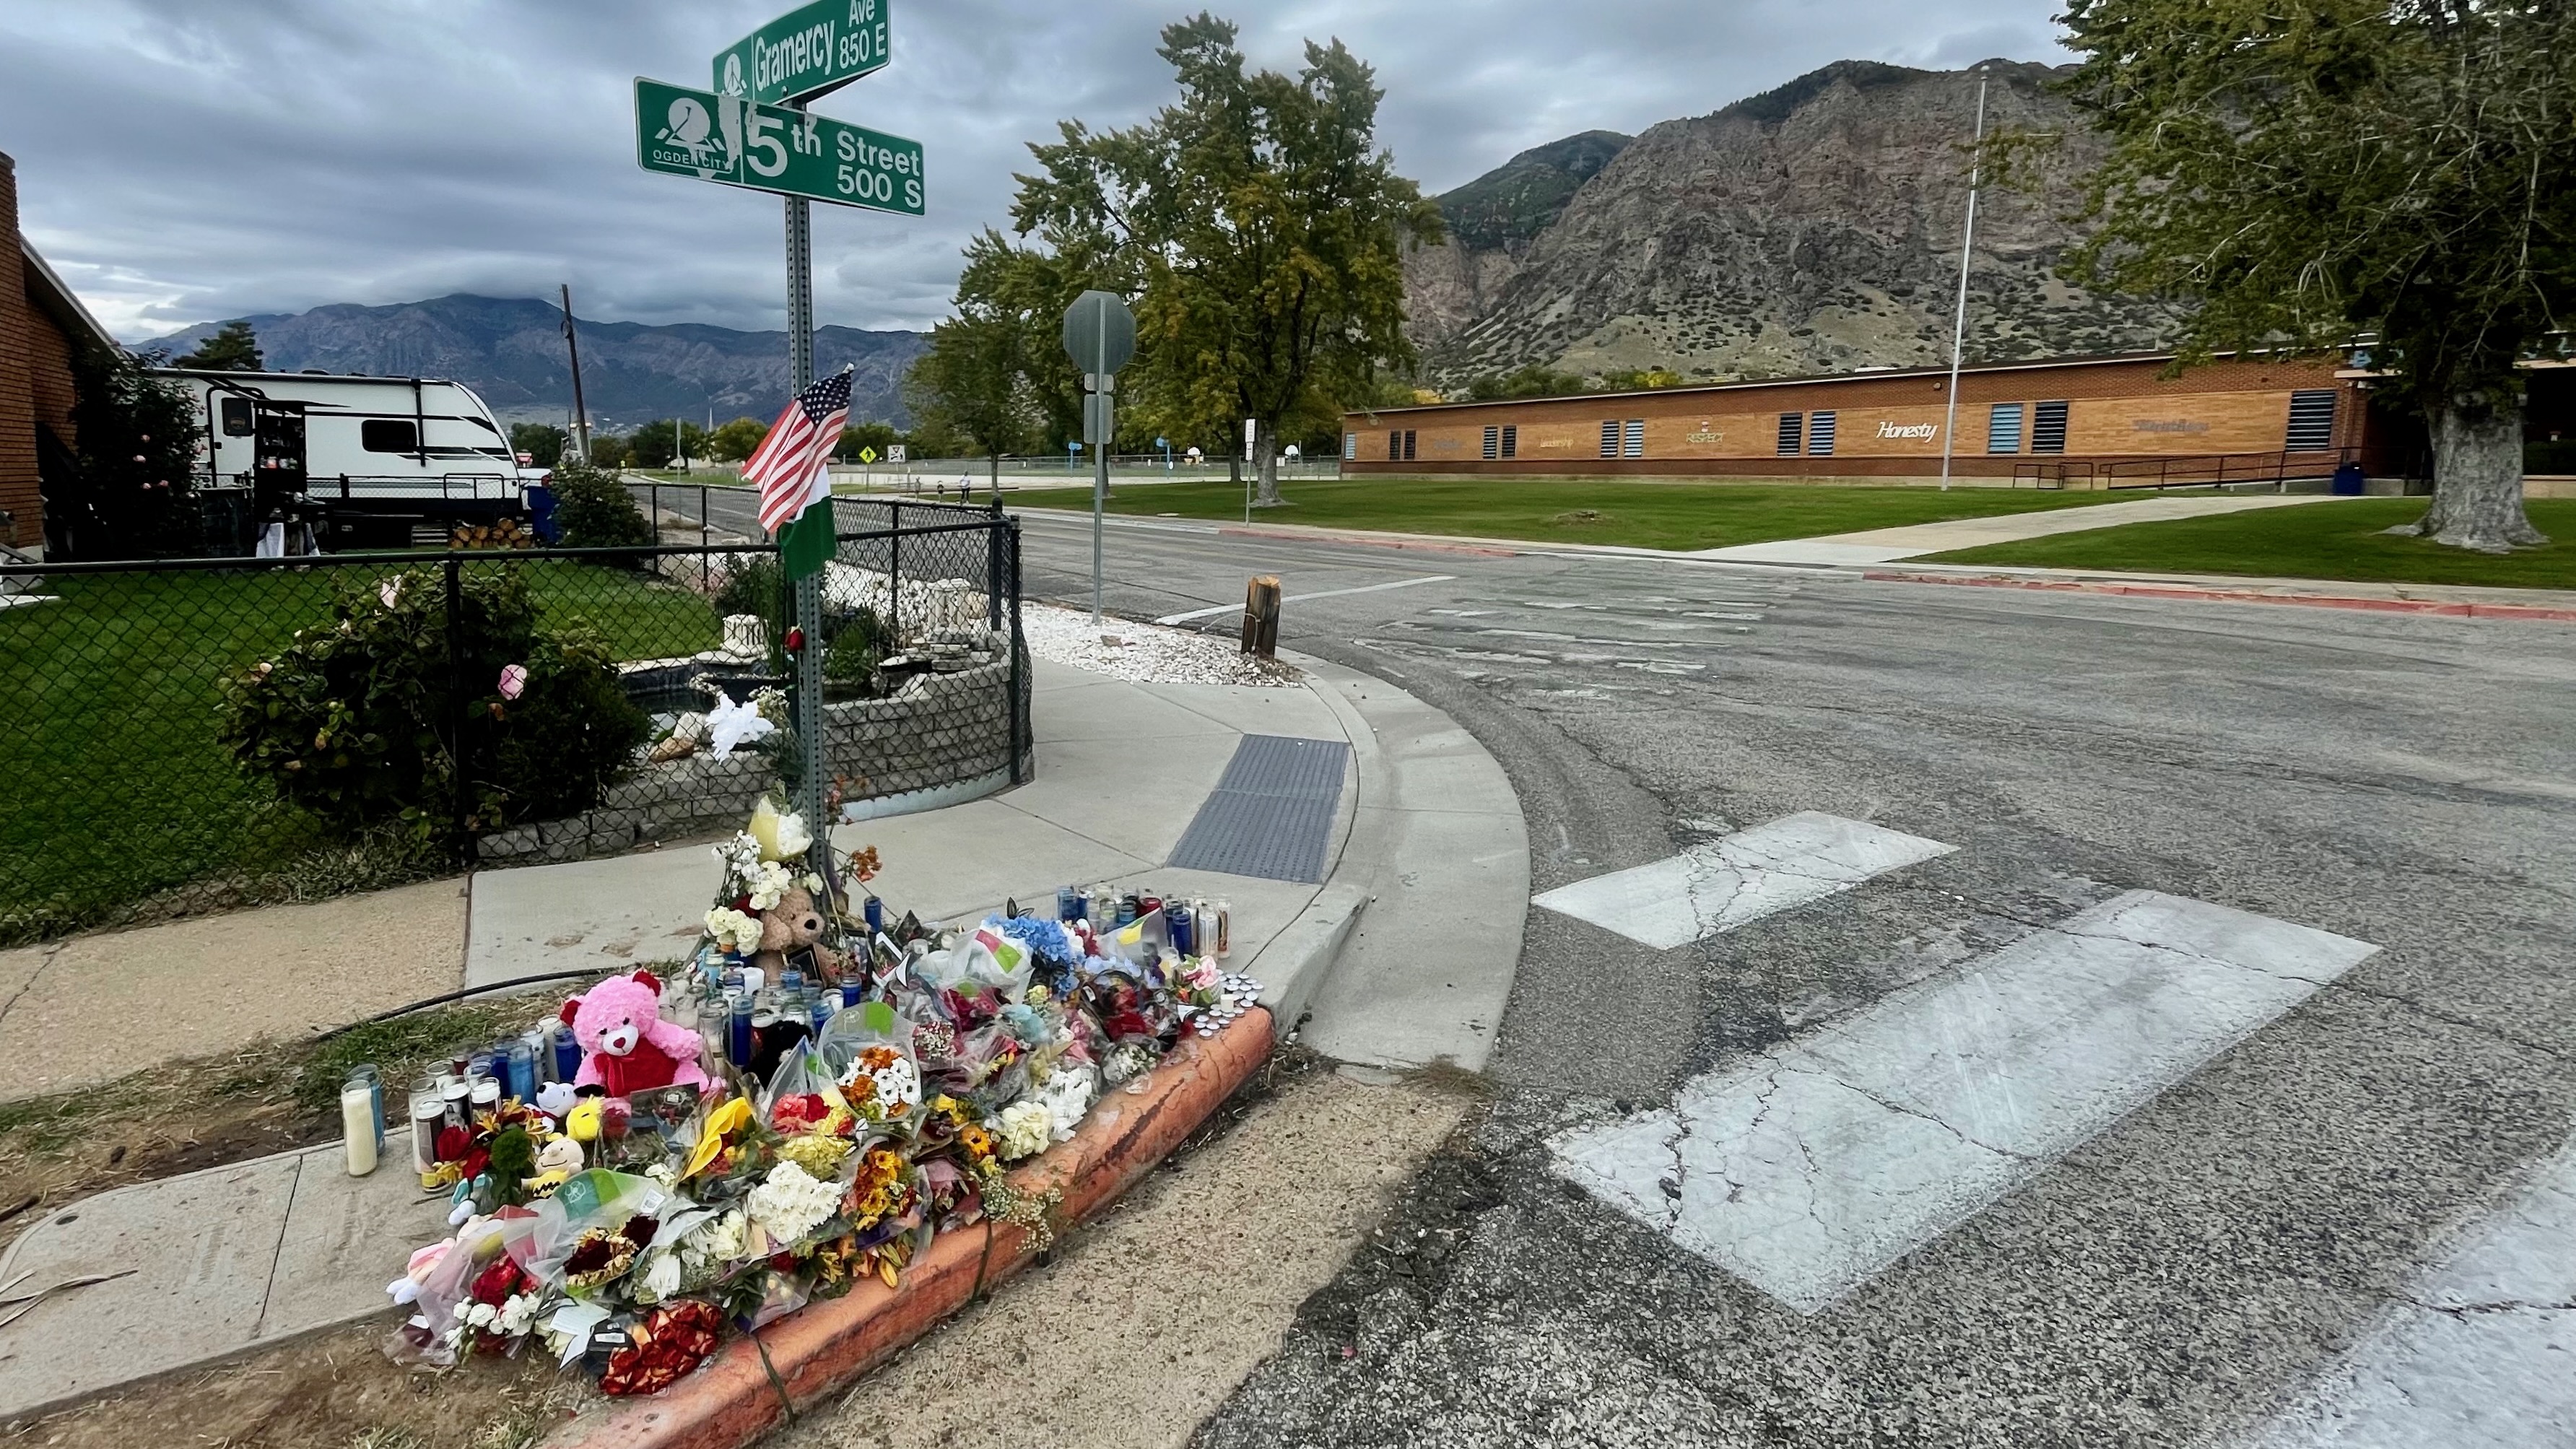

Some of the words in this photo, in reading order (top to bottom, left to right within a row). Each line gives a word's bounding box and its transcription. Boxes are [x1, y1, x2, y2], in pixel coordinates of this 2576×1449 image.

[755, 19, 835, 92] Gramercy
[848, 0, 875, 27] Ave
[840, 29, 869, 69] 850
[876, 22, 885, 56] E
[746, 116, 822, 177] 5th
[837, 131, 920, 177] Street
[837, 165, 892, 202] 500
[905, 179, 922, 208] S
[1876, 421, 1938, 443] Honesty
